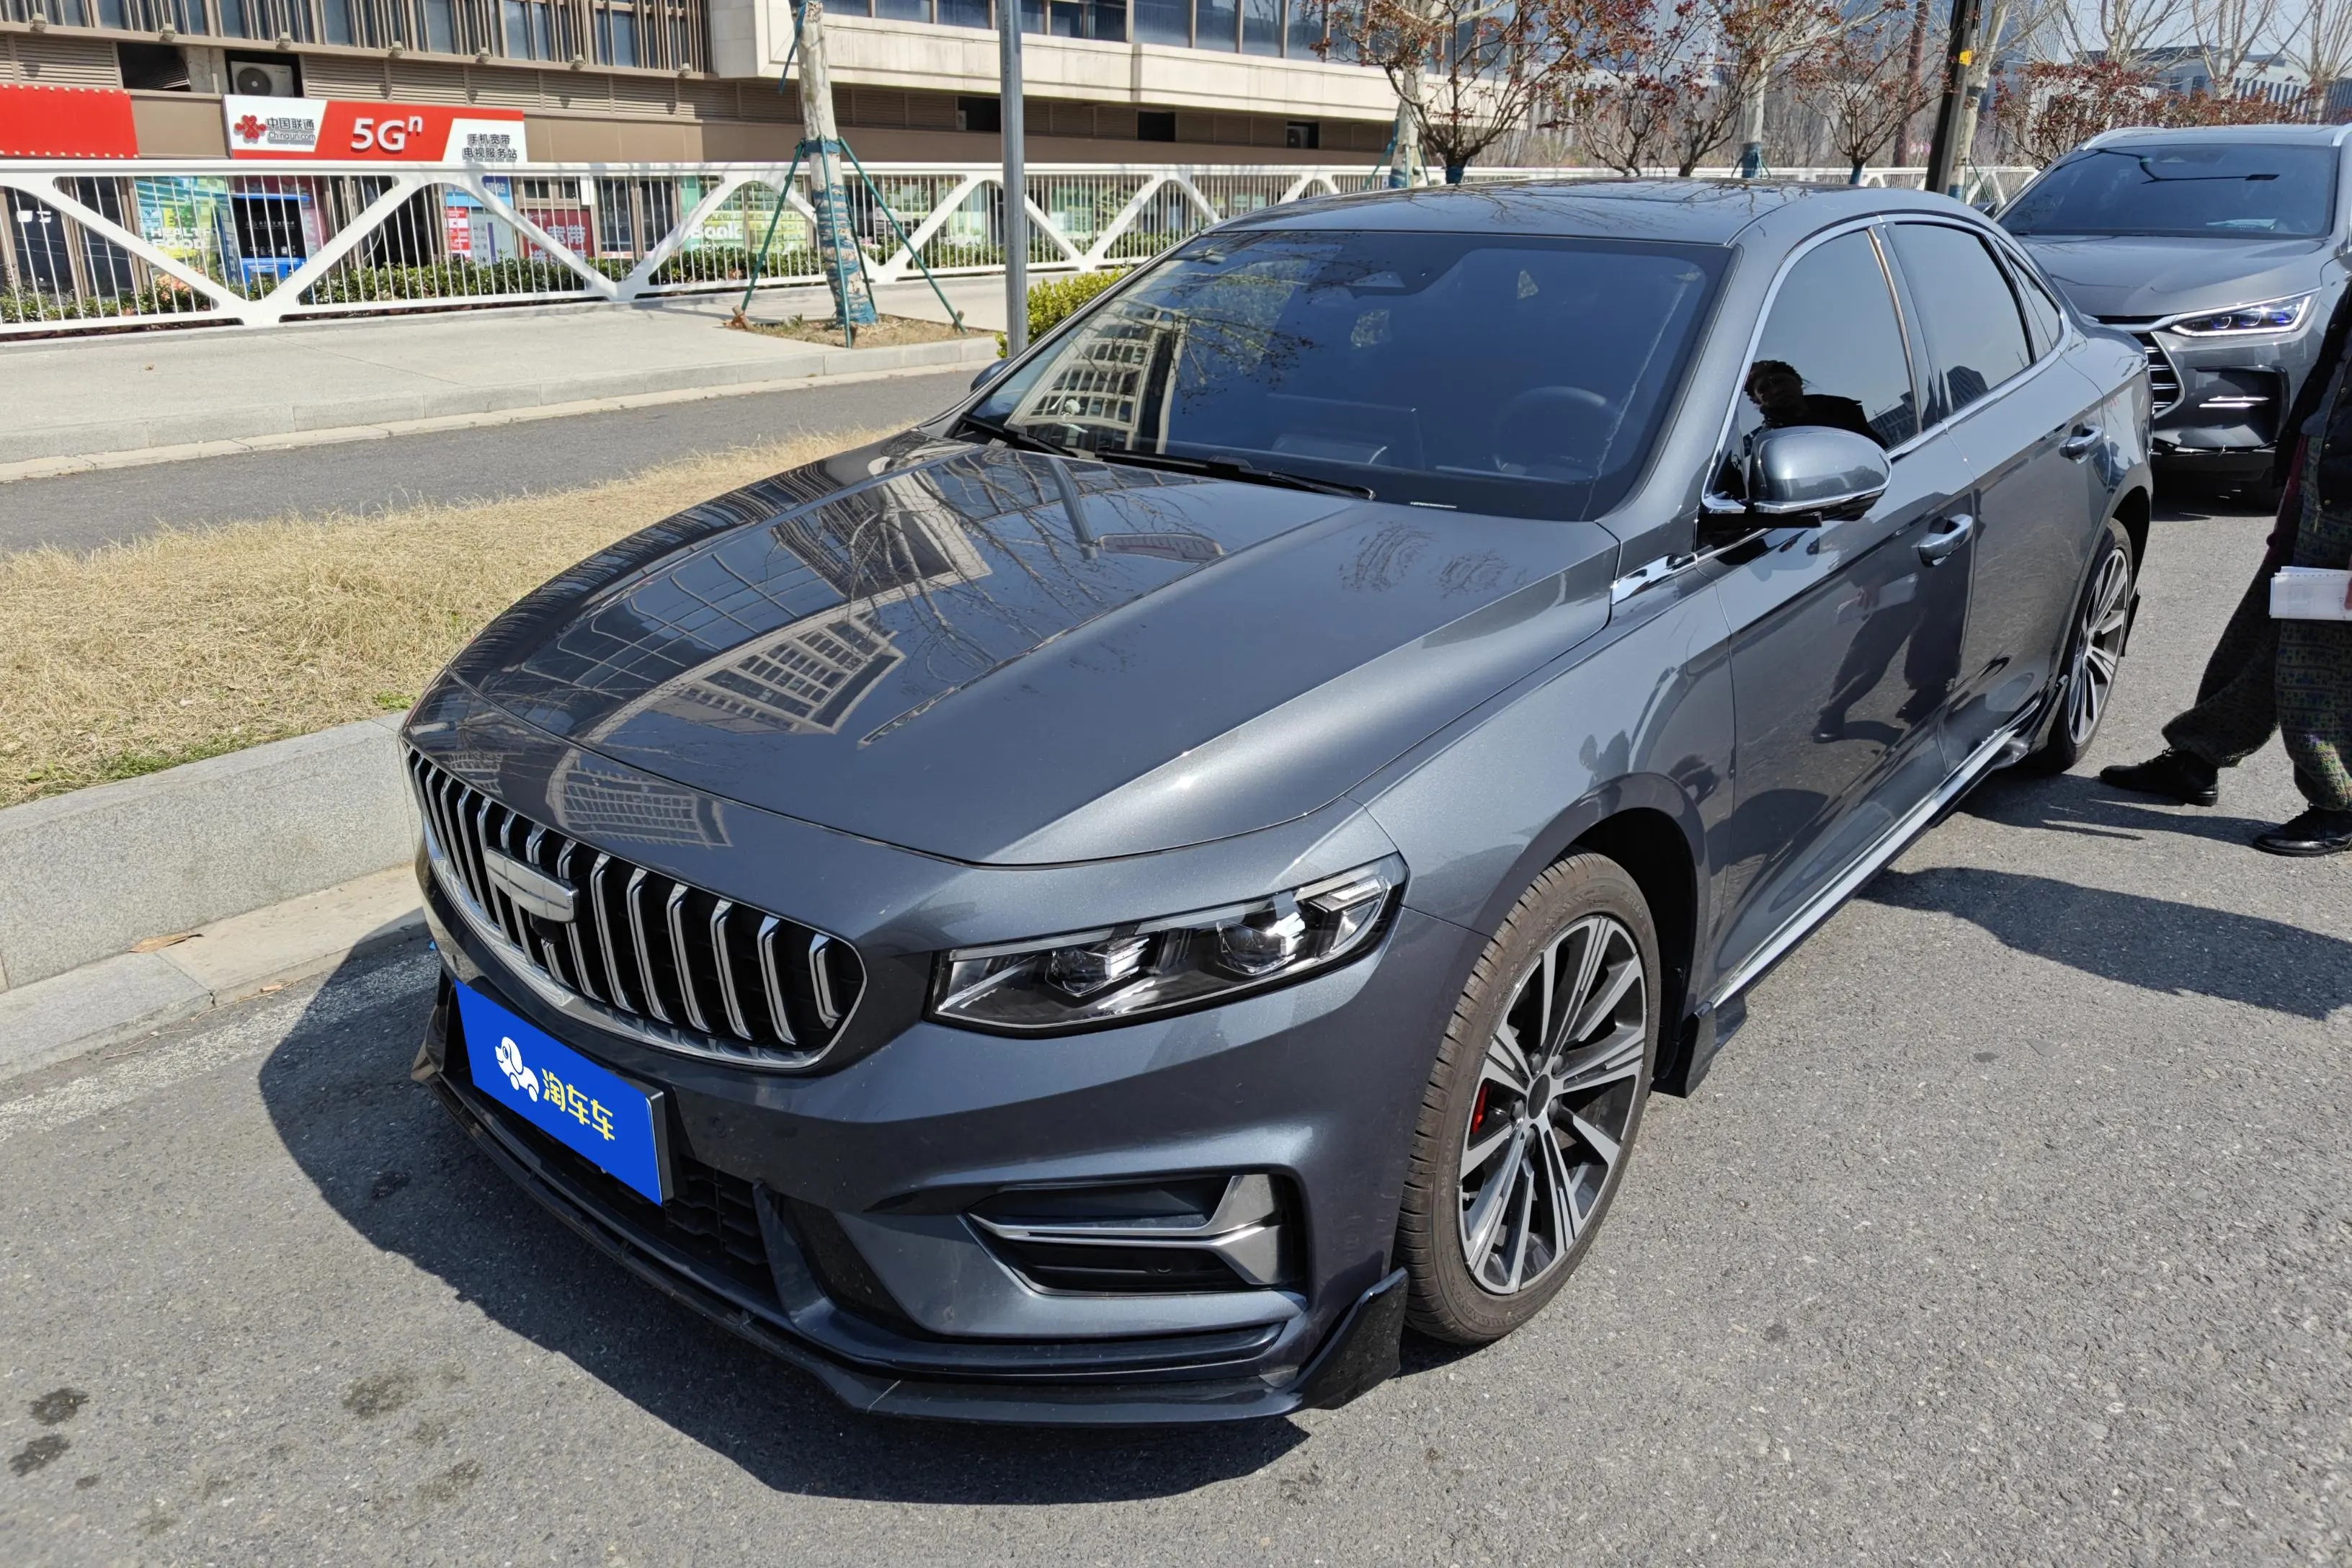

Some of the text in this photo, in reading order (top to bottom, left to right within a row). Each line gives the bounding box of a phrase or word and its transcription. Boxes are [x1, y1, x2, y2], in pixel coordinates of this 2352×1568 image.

[267, 117, 314, 130] 中国联通
[468, 133, 511, 145] 手机宽带
[463, 147, 517, 159] 电视服务站
